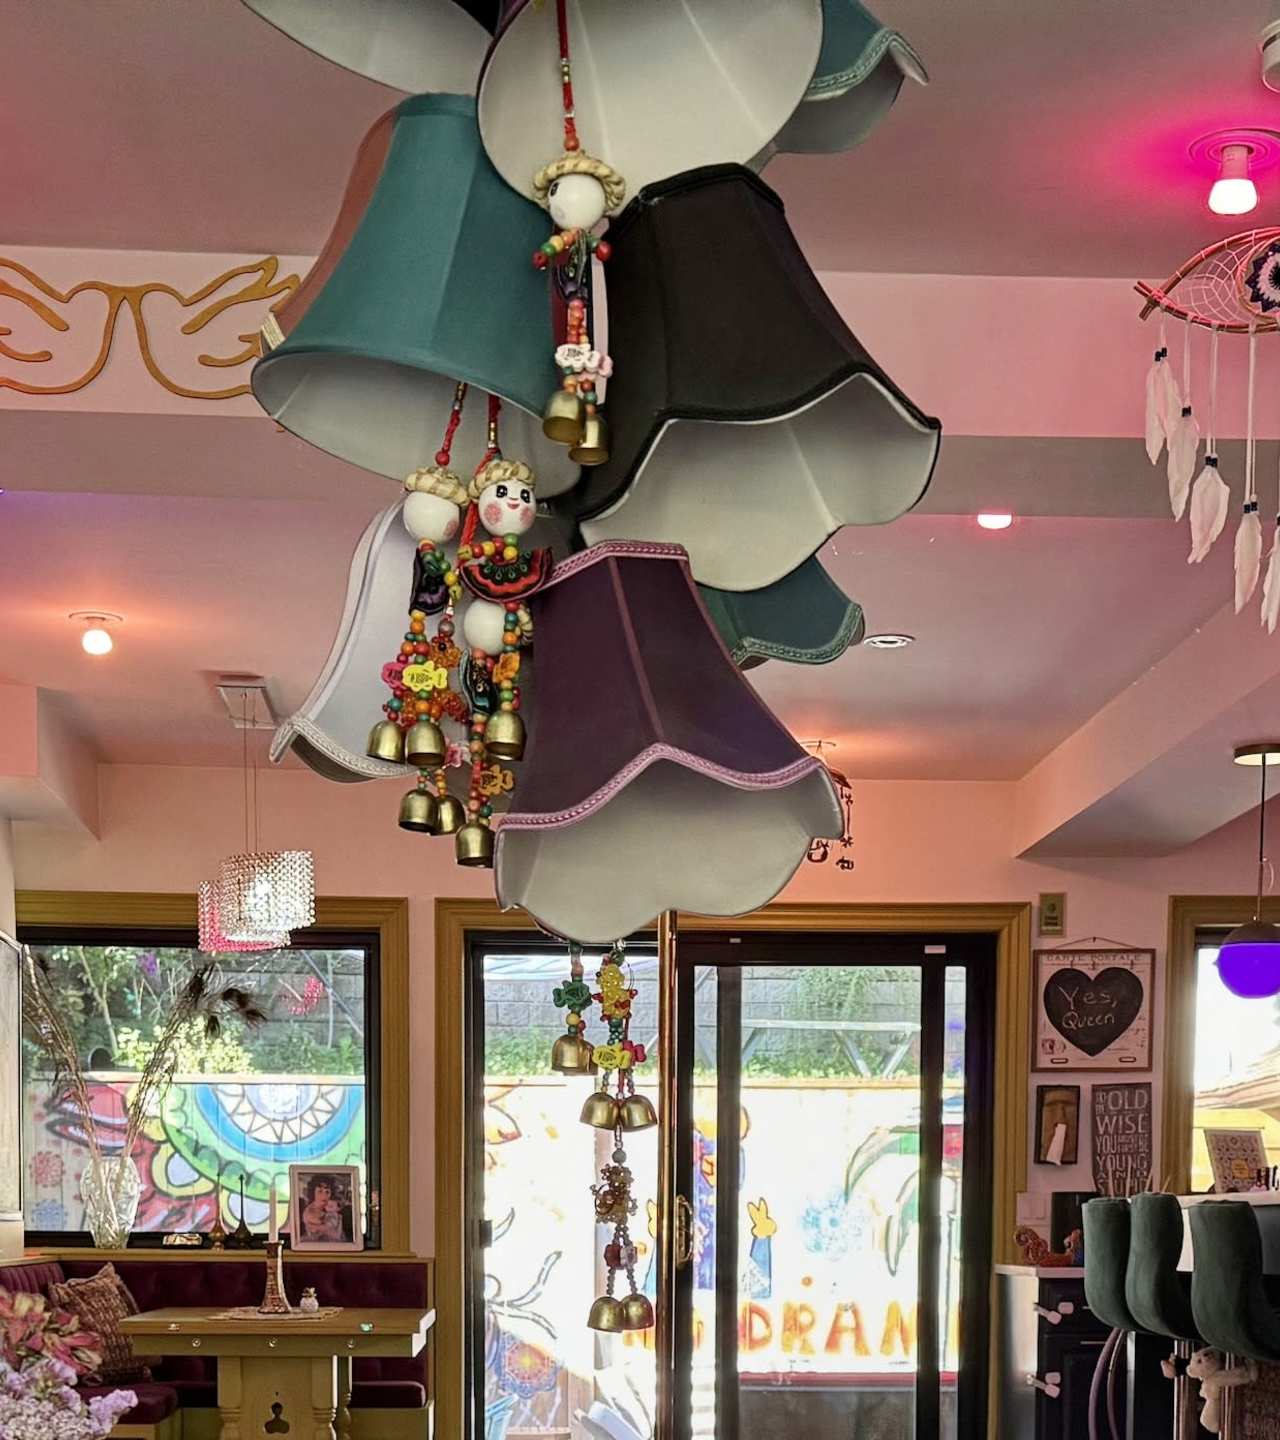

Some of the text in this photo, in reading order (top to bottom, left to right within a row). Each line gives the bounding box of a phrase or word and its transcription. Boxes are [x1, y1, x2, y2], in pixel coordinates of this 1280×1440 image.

[1054, 983, 1118, 1010] Yes,
[1061, 1011, 1115, 1030] Queen
[1108, 1089, 1148, 1111] OLD
[1095, 1113, 1149, 1135] WISE
[1095, 1135, 1117, 1154] YOU
